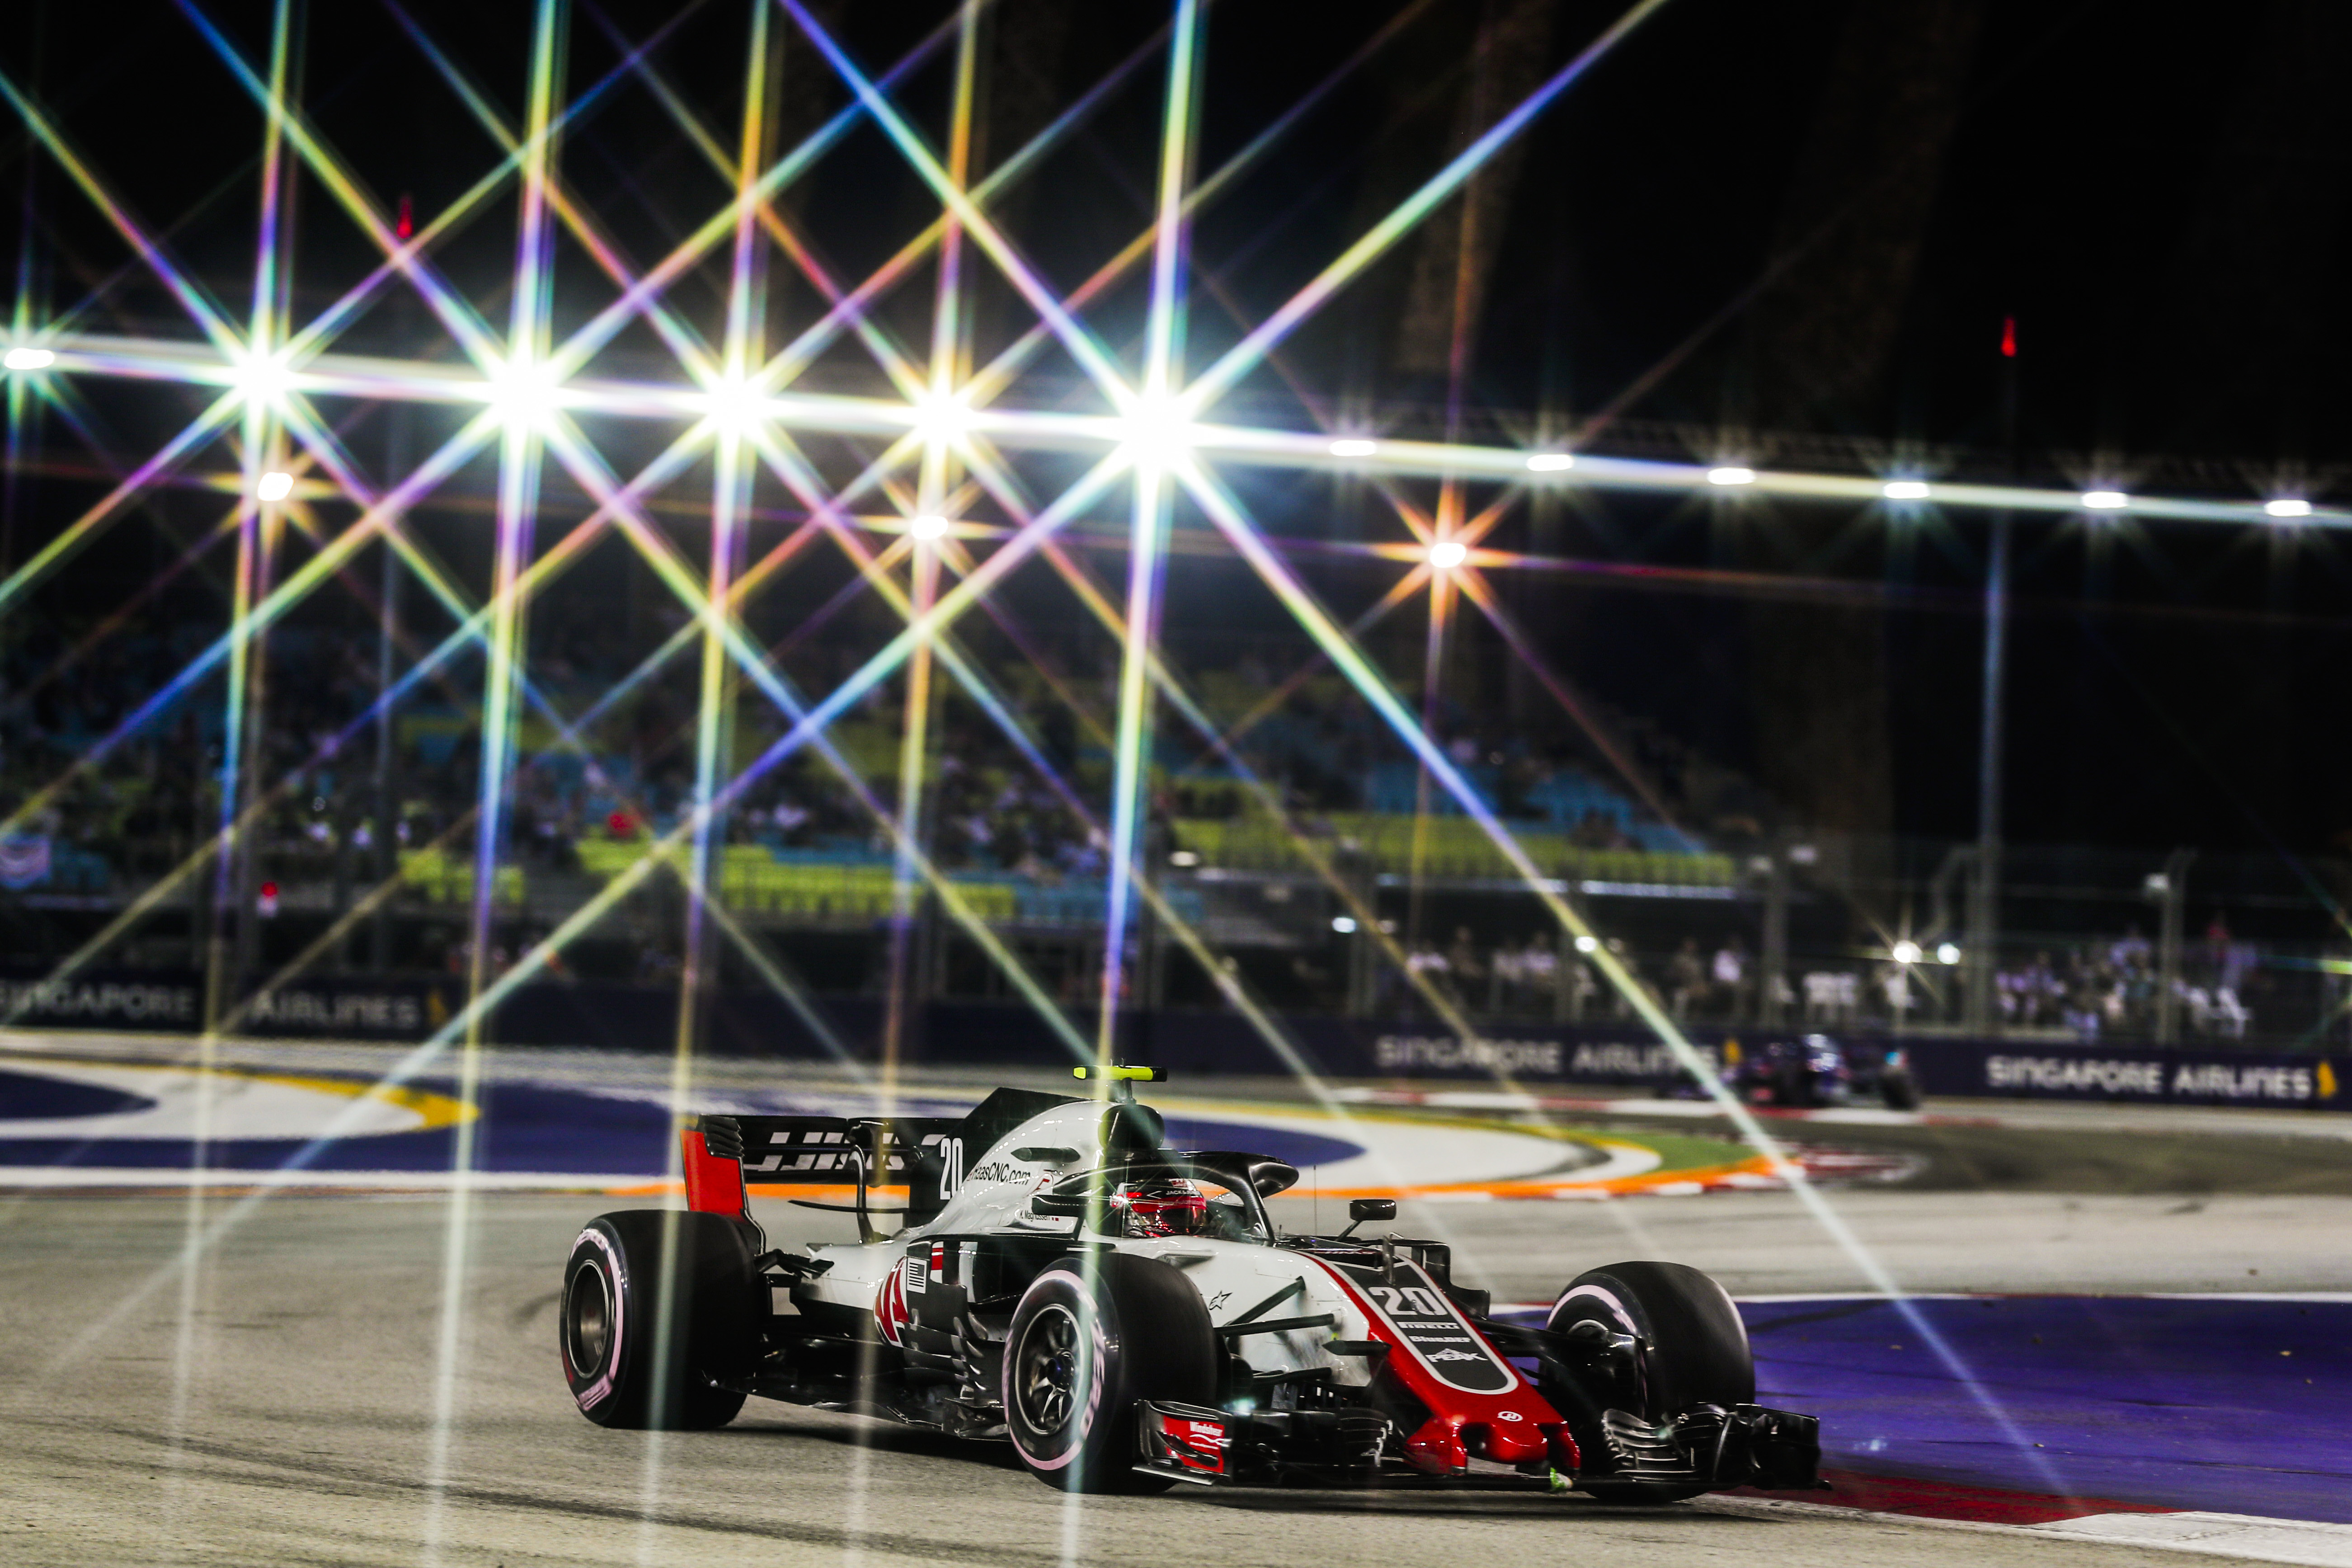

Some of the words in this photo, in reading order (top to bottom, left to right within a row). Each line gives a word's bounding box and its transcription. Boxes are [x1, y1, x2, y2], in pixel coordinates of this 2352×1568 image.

[1987, 1056, 2163, 1093] SINGAPORE
[2172, 1063, 2311, 1099] AIRLINES
[940, 1137, 963, 1200] 20
[1368, 1286, 1448, 1315] 20
[1396, 1321, 1460, 1329] PIRELLI
[1425, 1351, 1488, 1363] PEAK
